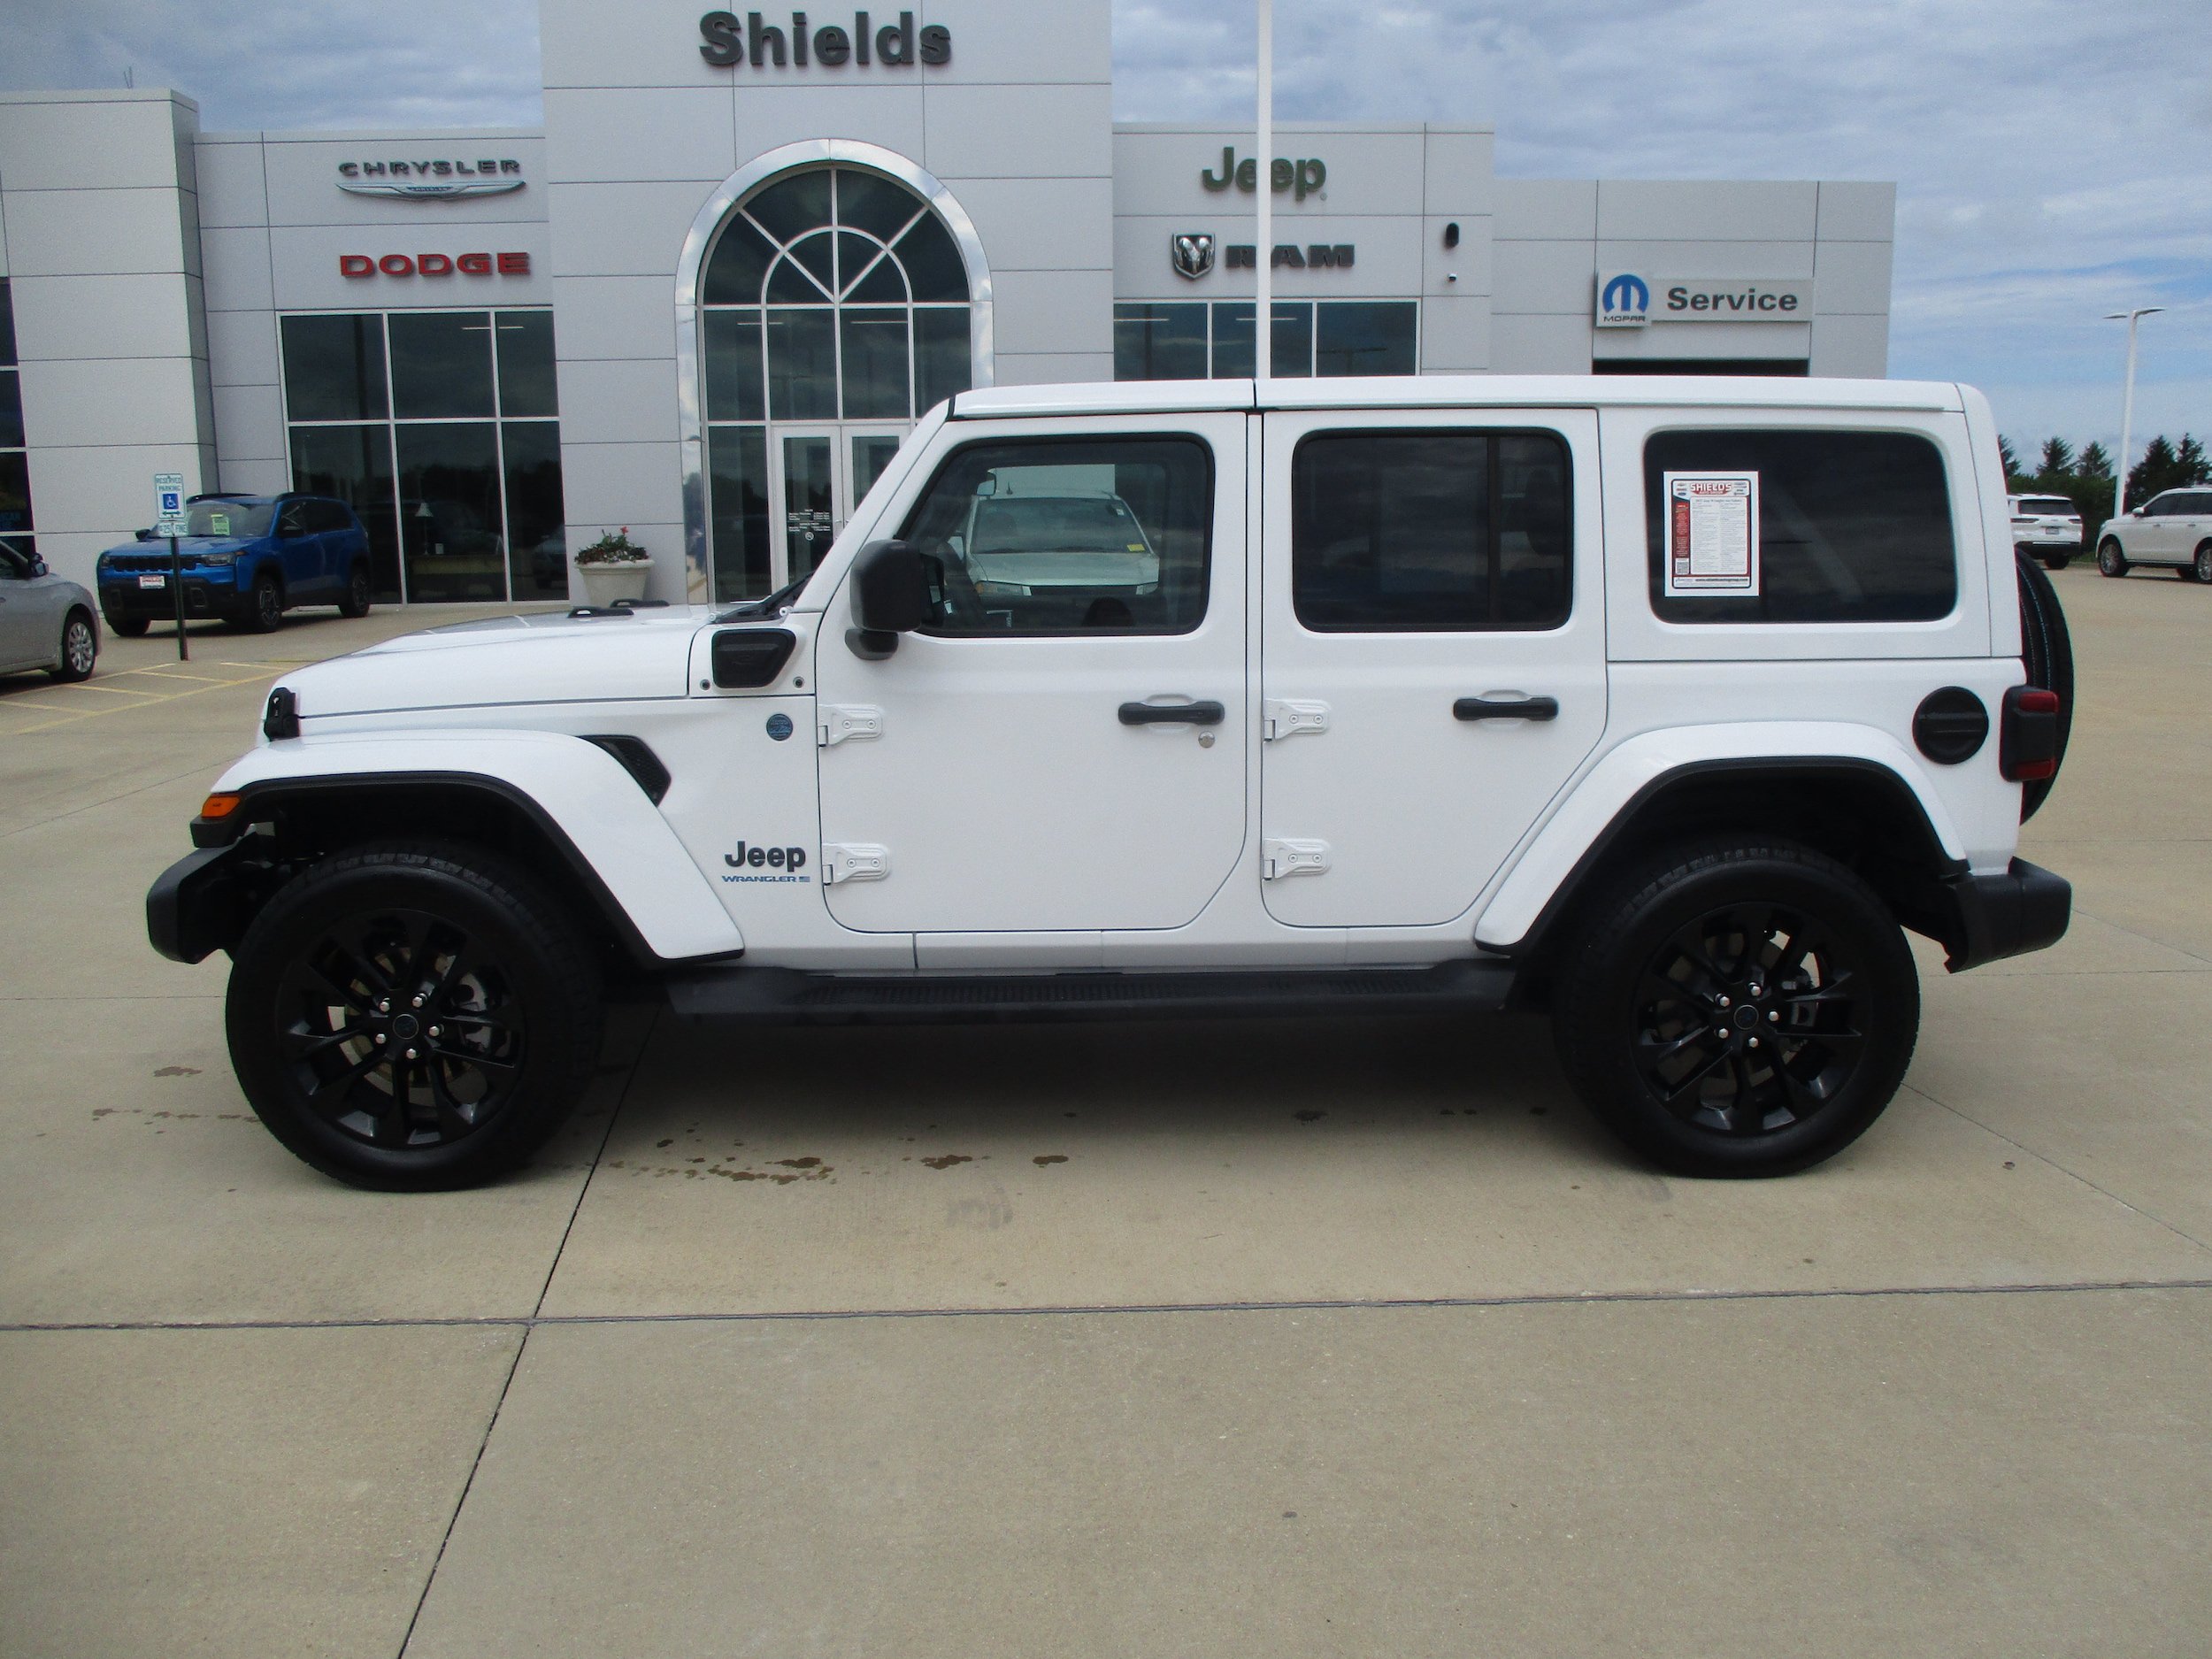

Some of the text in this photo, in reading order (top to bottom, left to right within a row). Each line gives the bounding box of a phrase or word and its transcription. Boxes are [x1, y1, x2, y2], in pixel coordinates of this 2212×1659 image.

[699, 11, 952, 65] Shields
[338, 159, 521, 177] CHRYSLER
[1202, 146, 1327, 202] Jeep
[340, 252, 531, 278] DODGE
[1225, 244, 1356, 269] RAM
[1667, 287, 1799, 312] Service
[1690, 482, 1732, 492] SHIELDS
[725, 841, 806, 872] Jeep
